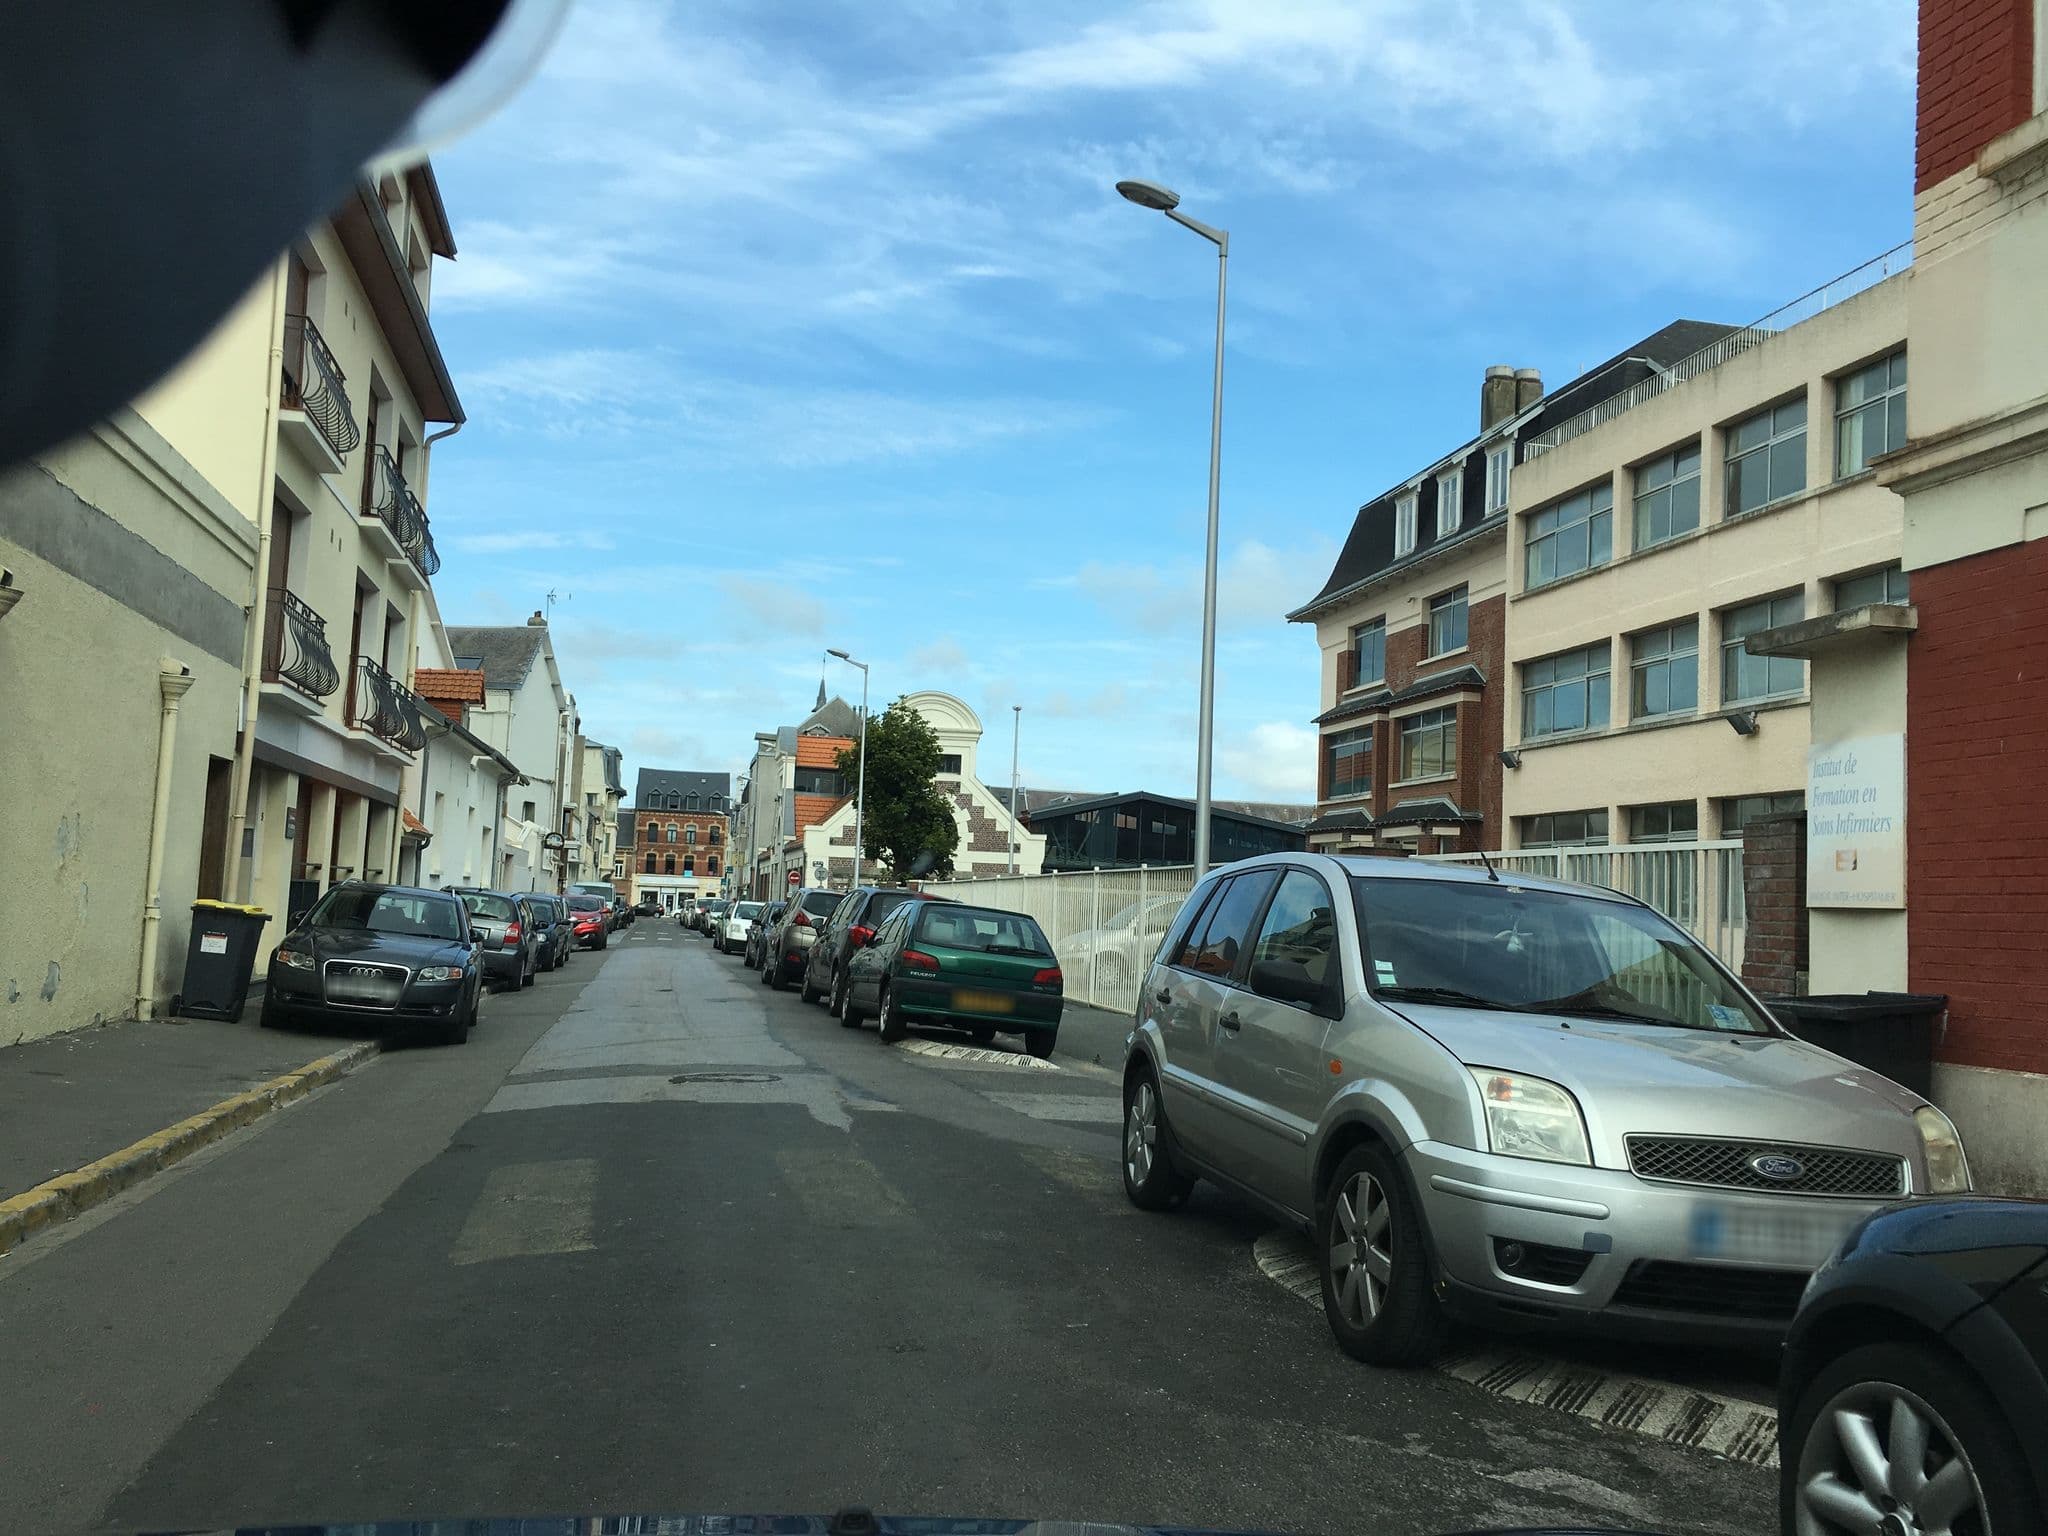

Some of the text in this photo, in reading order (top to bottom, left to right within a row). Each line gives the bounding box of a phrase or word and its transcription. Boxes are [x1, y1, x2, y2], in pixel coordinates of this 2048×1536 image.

[1813, 752, 1857, 778] Institut de
[1813, 784, 1877, 807] Formation en
[1813, 812, 1891, 840] Soins Infirmiers
[1765, 1159, 1795, 1173] Ford
